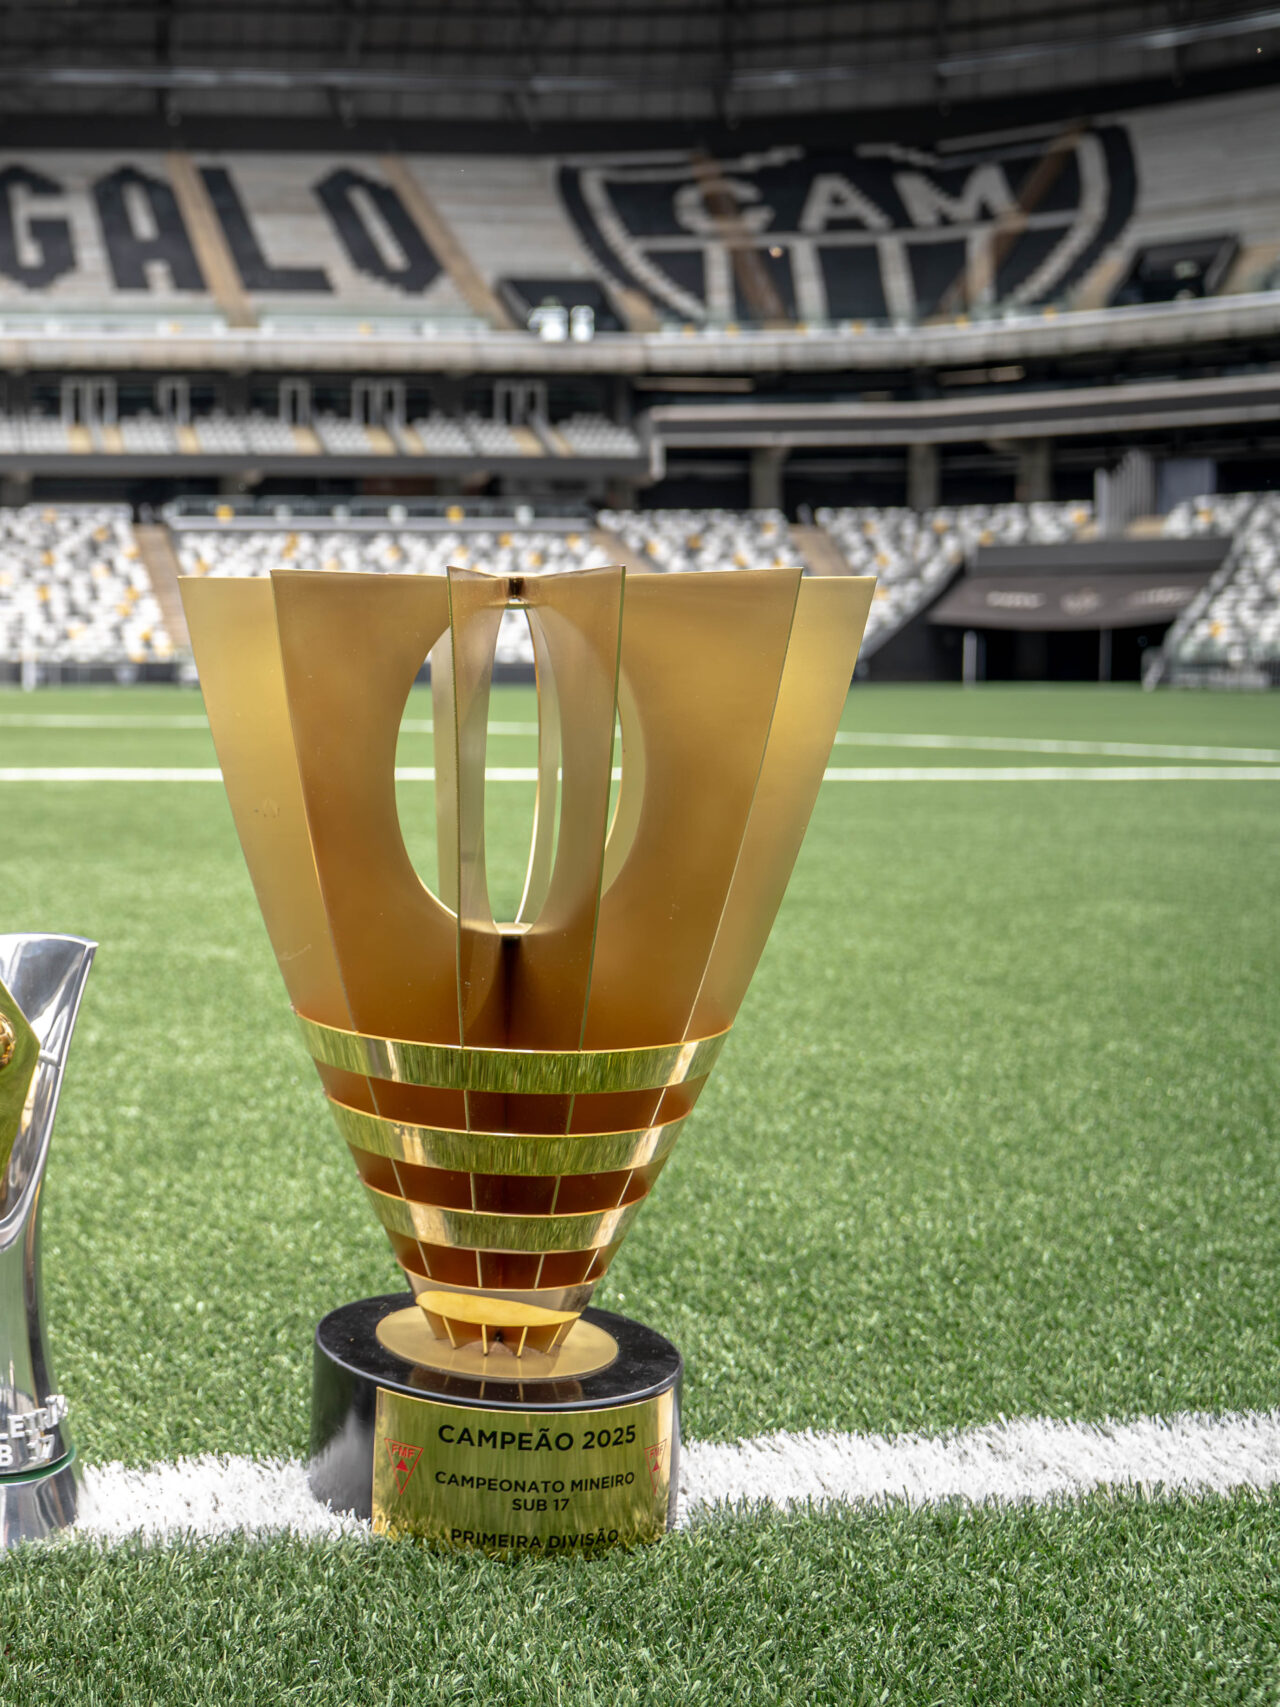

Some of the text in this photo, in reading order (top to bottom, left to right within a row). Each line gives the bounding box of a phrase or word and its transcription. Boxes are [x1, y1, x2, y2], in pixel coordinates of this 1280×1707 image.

[672, 162, 1022, 234] CAM
[438, 1424, 636, 1451] CAMPEÃO 2025
[391, 1443, 416, 1460] FMF
[435, 1471, 635, 1493] CAMPEONATO MINEIRO
[512, 1498, 570, 1511] SUB 17
[451, 1527, 619, 1549] PRIMEIRA DIVISÃO
